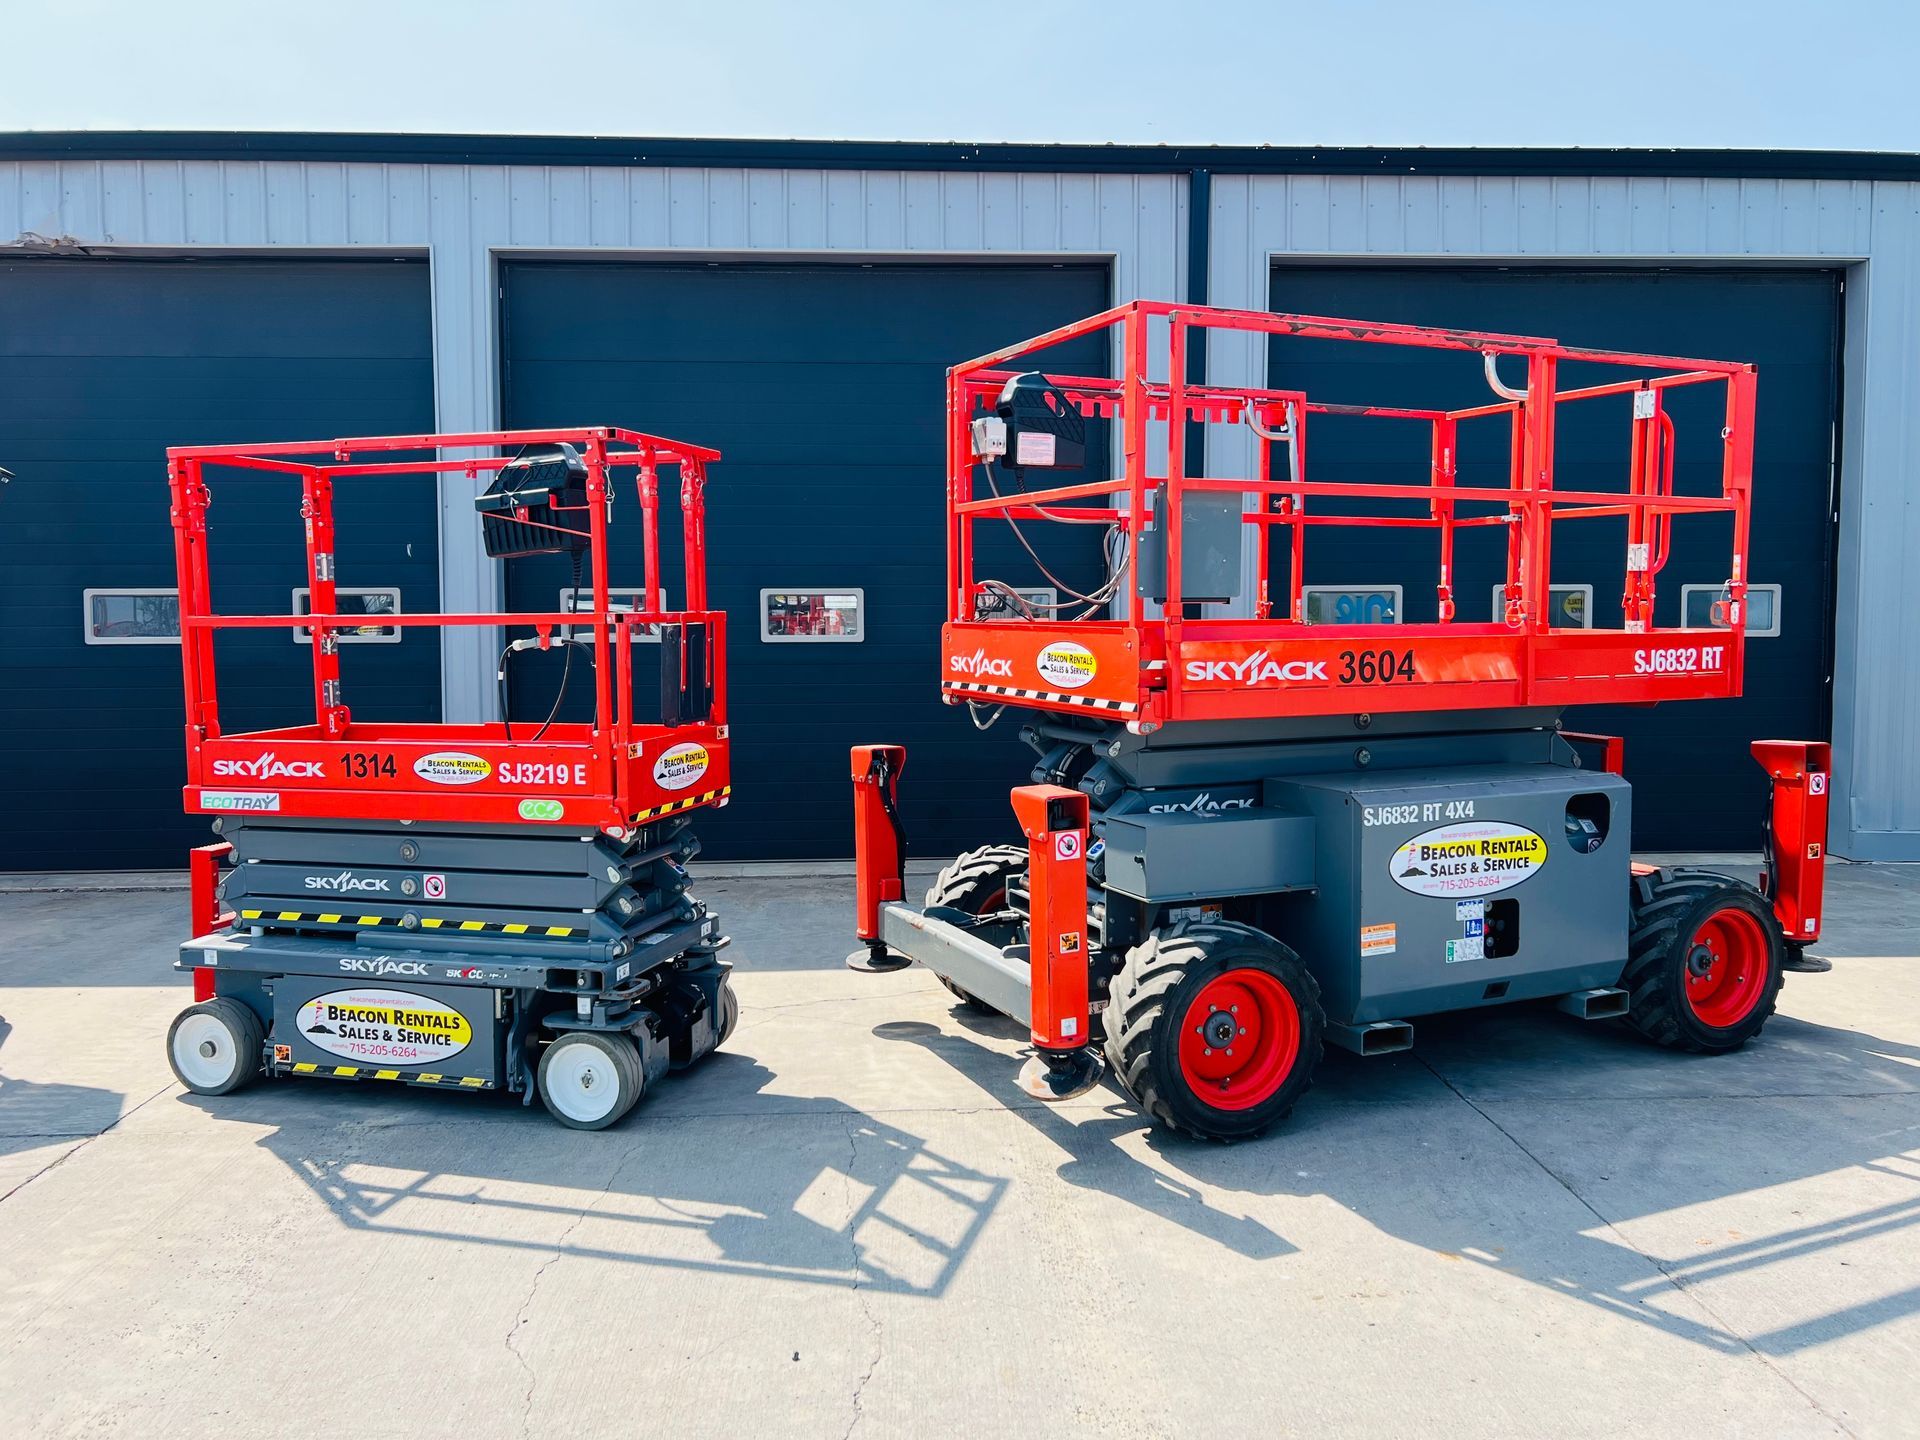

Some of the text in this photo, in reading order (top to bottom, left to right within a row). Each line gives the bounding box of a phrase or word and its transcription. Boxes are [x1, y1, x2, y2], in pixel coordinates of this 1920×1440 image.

[950, 648, 1013, 677] SKYJACK
[1047, 653, 1093, 665] BEACON RENTALS
[1050, 664, 1065, 673] SALES
[1185, 650, 1329, 685] SKYJACK
[1339, 650, 1416, 683] 3604
[1634, 646, 1724, 673] SJ6832 RT
[213, 752, 326, 780] SKYJACK
[340, 753, 397, 778] 1314
[427, 760, 487, 769] BEACON RENTALS
[458, 768, 483, 776] SERVICE
[499, 763, 586, 785] SJ3219 E
[203, 795, 277, 810] ECOTRAY
[1363, 800, 1475, 826] SJ6832 RT 4X4
[1421, 839, 1538, 861] BEACON RENTALS
[1430, 856, 1530, 877] SALES & SERVICE
[304, 871, 390, 893] SKYJACK
[1440, 875, 1500, 891] 715-205-6264
[339, 955, 429, 976] SKYJACK
[328, 1005, 460, 1029] BEACON RENTALS
[339, 1024, 451, 1046] SALES & SERVICE
[350, 1043, 417, 1058] 715-205-6264
